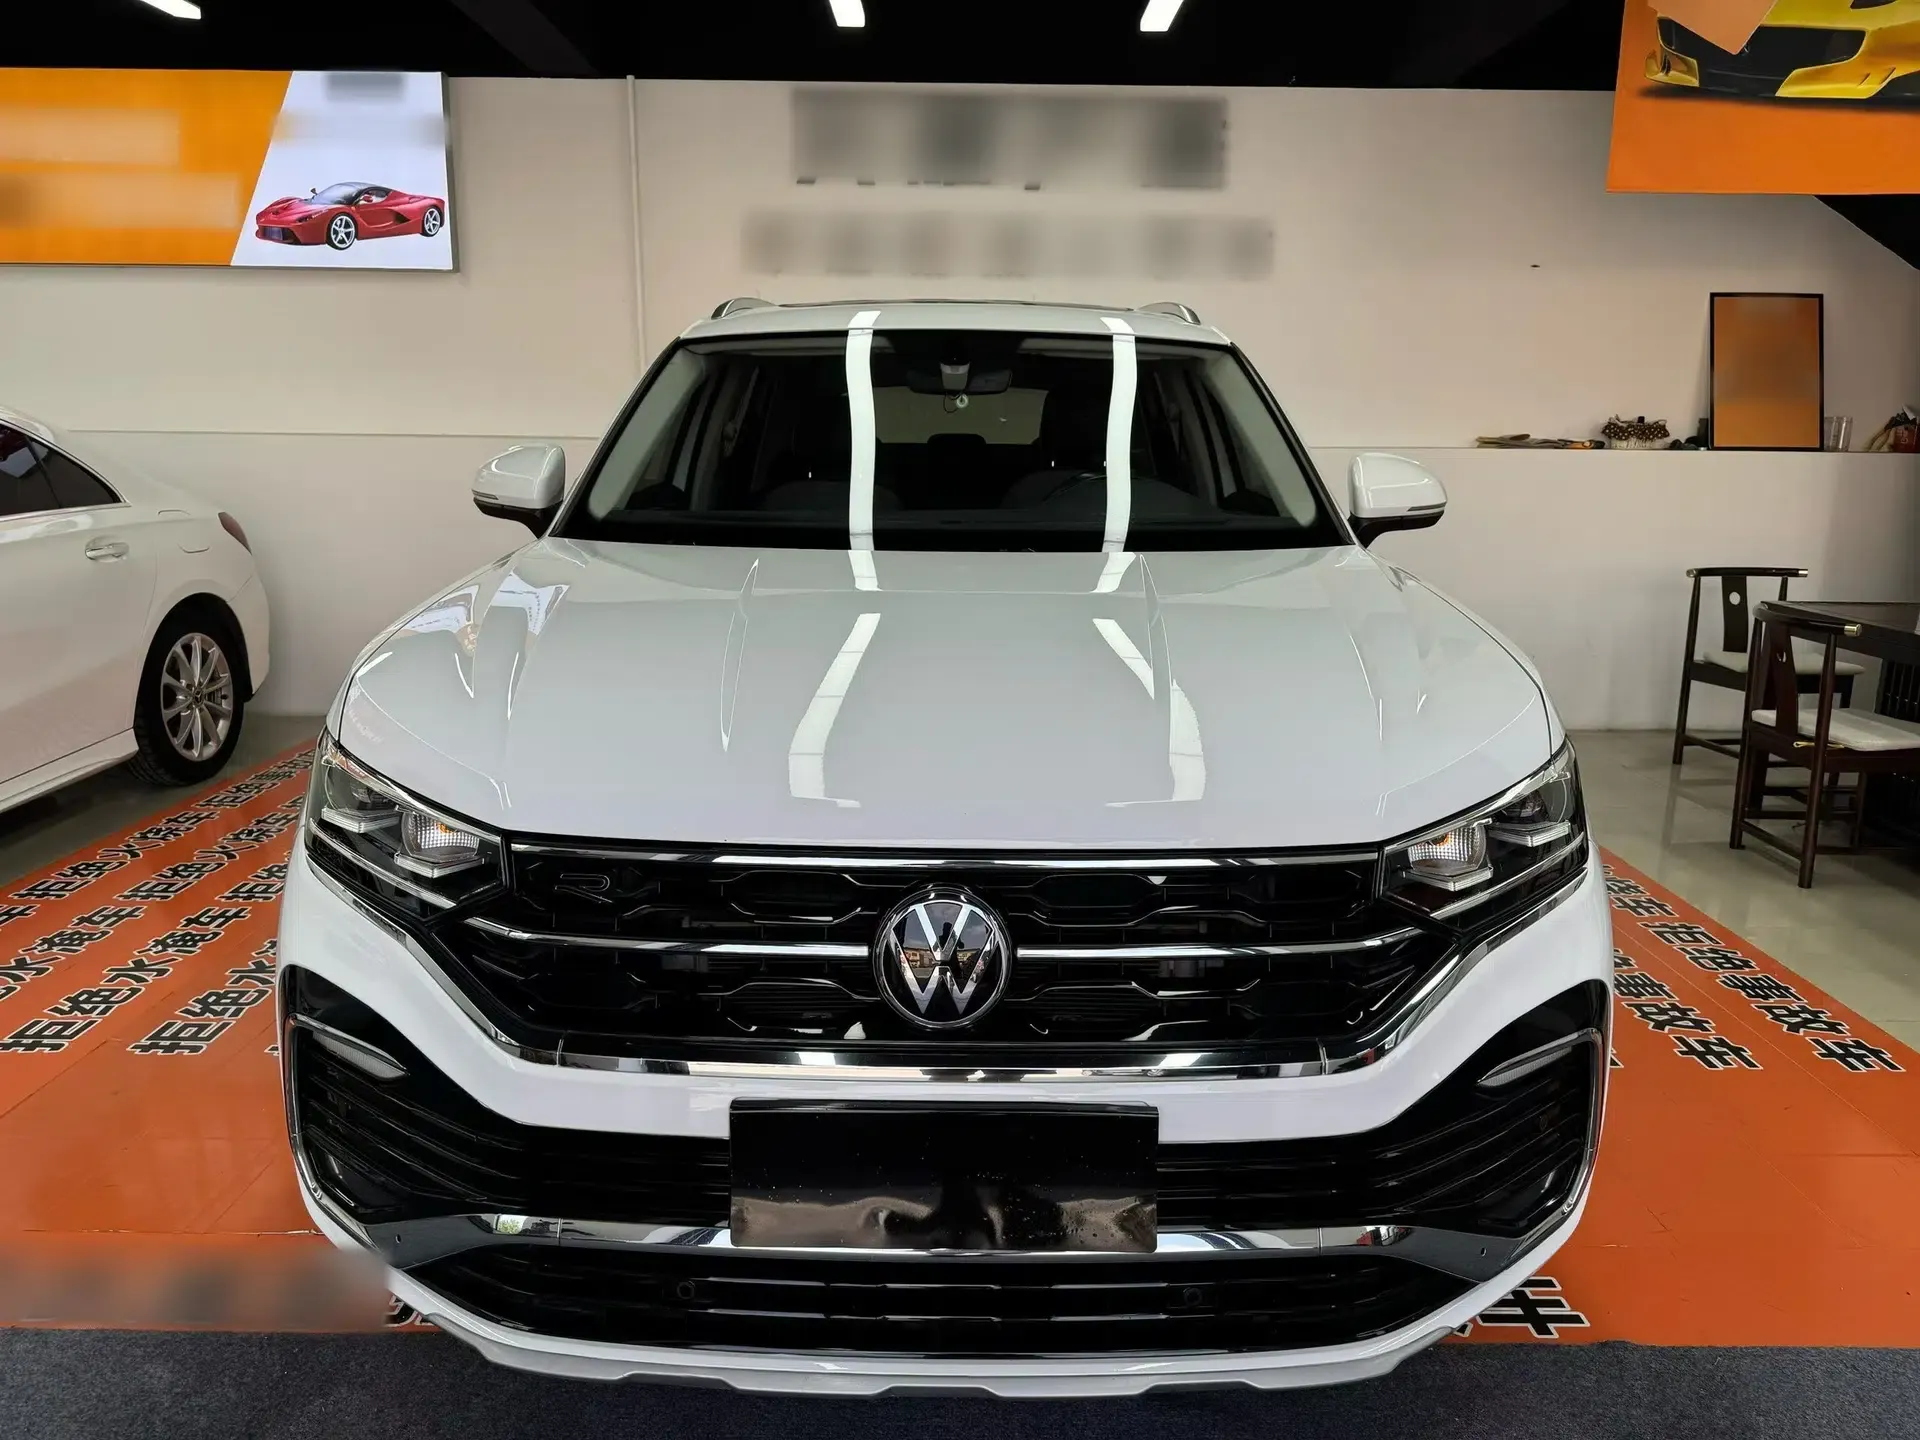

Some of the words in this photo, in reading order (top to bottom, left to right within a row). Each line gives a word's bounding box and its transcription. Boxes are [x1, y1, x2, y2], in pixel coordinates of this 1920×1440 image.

[8, 811, 220, 900] 拒绝火烧车
[0, 905, 252, 1054] 拒绝水淹车
[1637, 921, 1906, 1072] 拒绝事故车
